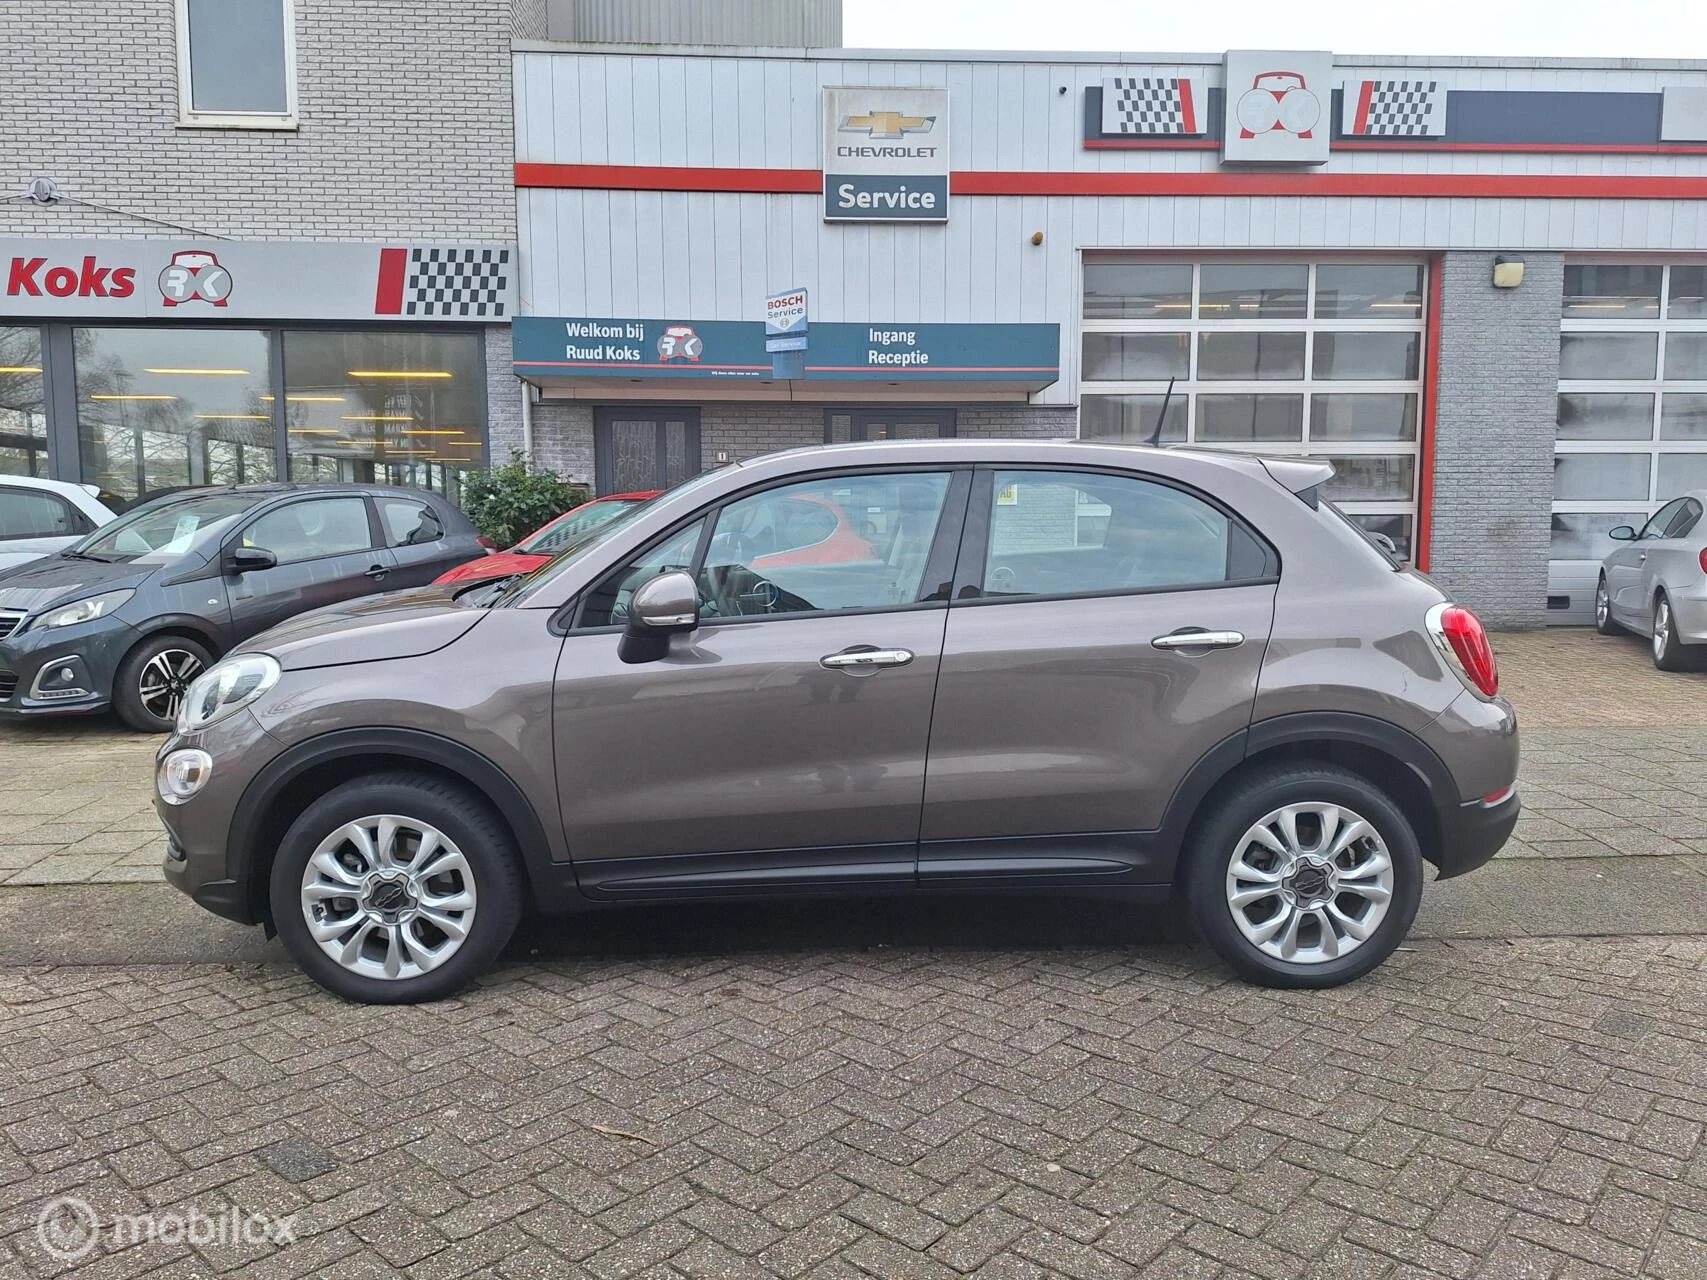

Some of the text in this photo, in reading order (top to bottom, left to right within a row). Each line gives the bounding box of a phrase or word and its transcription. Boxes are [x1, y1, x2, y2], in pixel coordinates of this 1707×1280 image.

[837, 146, 937, 158] CHEVROLET
[838, 183, 936, 209] Service
[7, 256, 136, 298] Koks
[767, 295, 804, 309] BOSCH
[767, 306, 804, 319] Service
[566, 322, 644, 341] Welkom bij
[869, 328, 916, 345] Ingang
[566, 345, 641, 360] Ruud Koks
[868, 350, 929, 367] Receptie
